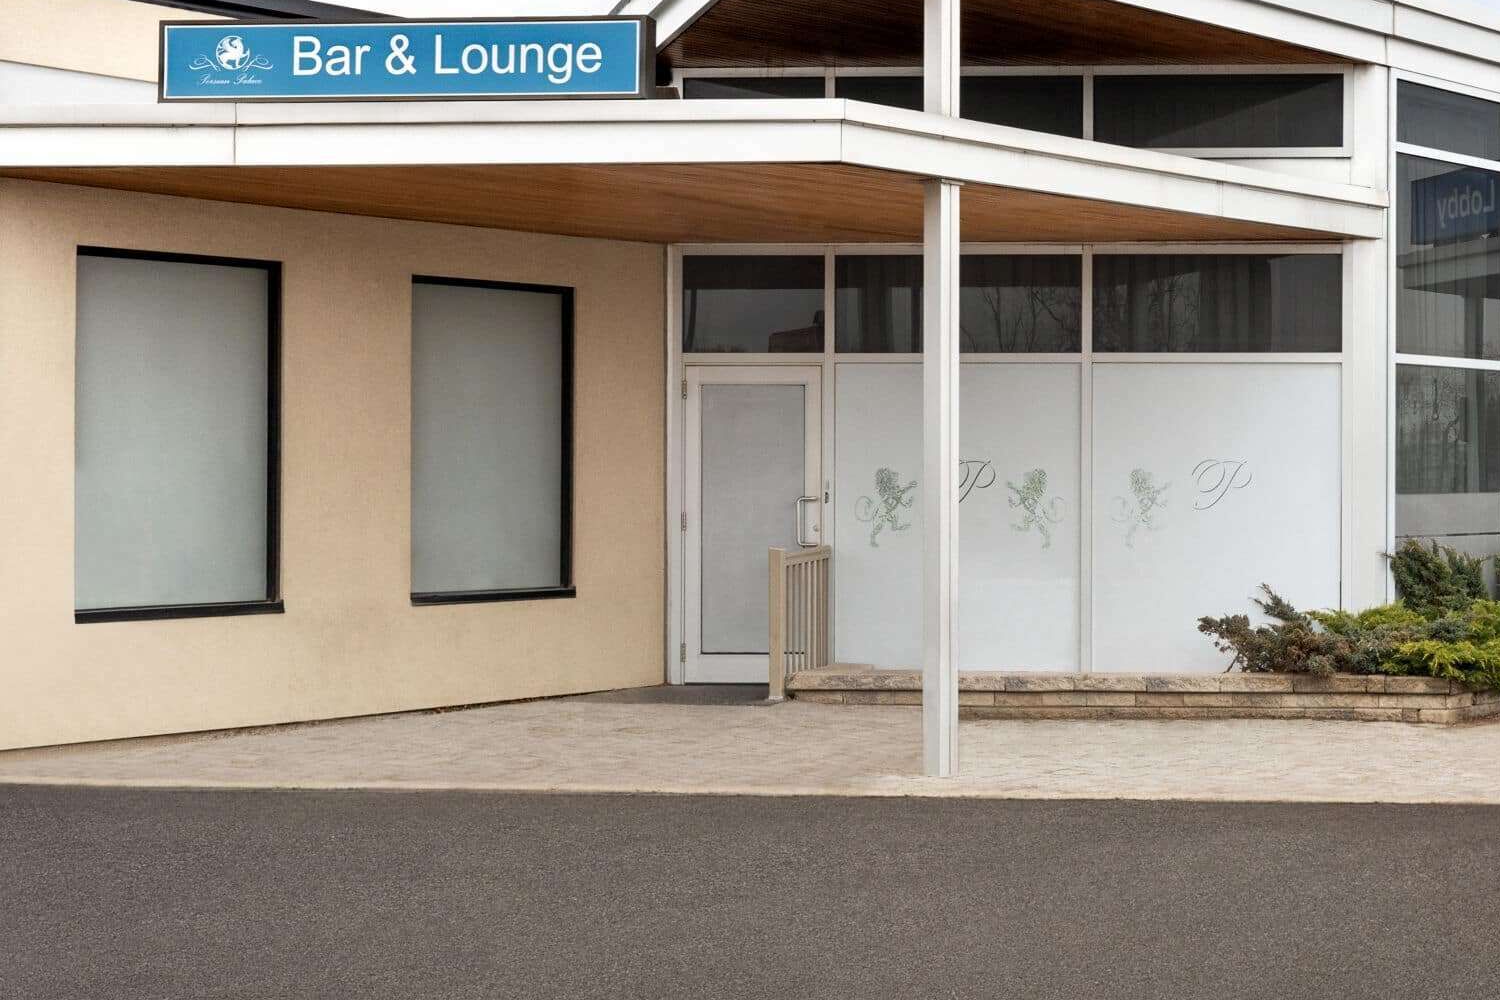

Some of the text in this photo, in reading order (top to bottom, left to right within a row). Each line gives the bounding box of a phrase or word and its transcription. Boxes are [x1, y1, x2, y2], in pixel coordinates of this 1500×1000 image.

[291, 34, 604, 86] Bar & Lounge
